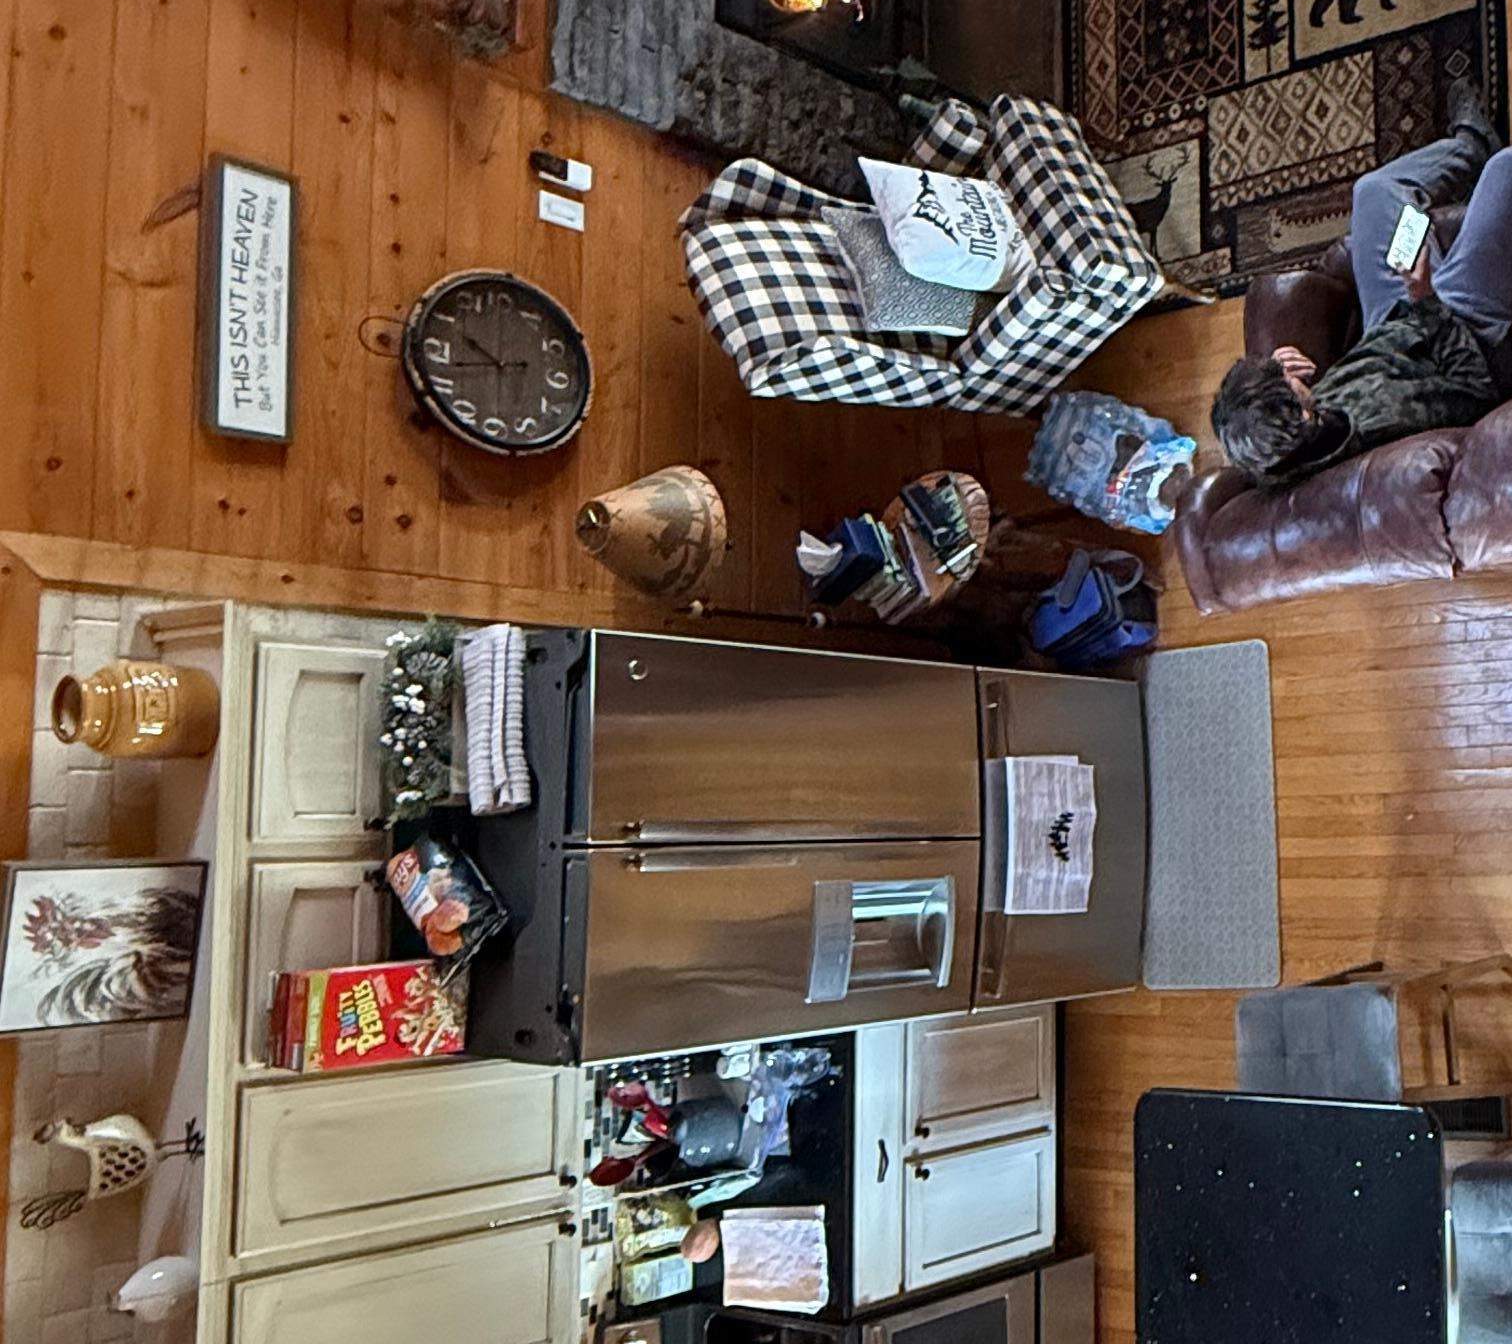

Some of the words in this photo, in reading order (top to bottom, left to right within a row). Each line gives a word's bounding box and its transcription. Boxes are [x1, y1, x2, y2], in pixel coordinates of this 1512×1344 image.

[260, 196, 278, 229] Here
[955, 210, 979, 237] The
[230, 187, 259, 284] HEAVEN
[254, 233, 270, 271] From
[252, 291, 268, 315] See
[228, 288, 249, 348] ISN'T
[252, 320, 269, 348] Can
[232, 353, 253, 409] THIS
[255, 354, 269, 381] You
[545, 370, 570, 390] 6
[258, 385, 274, 412] But
[482, 417, 508, 440] 9
[352, 979, 387, 1057] PEBBLES
